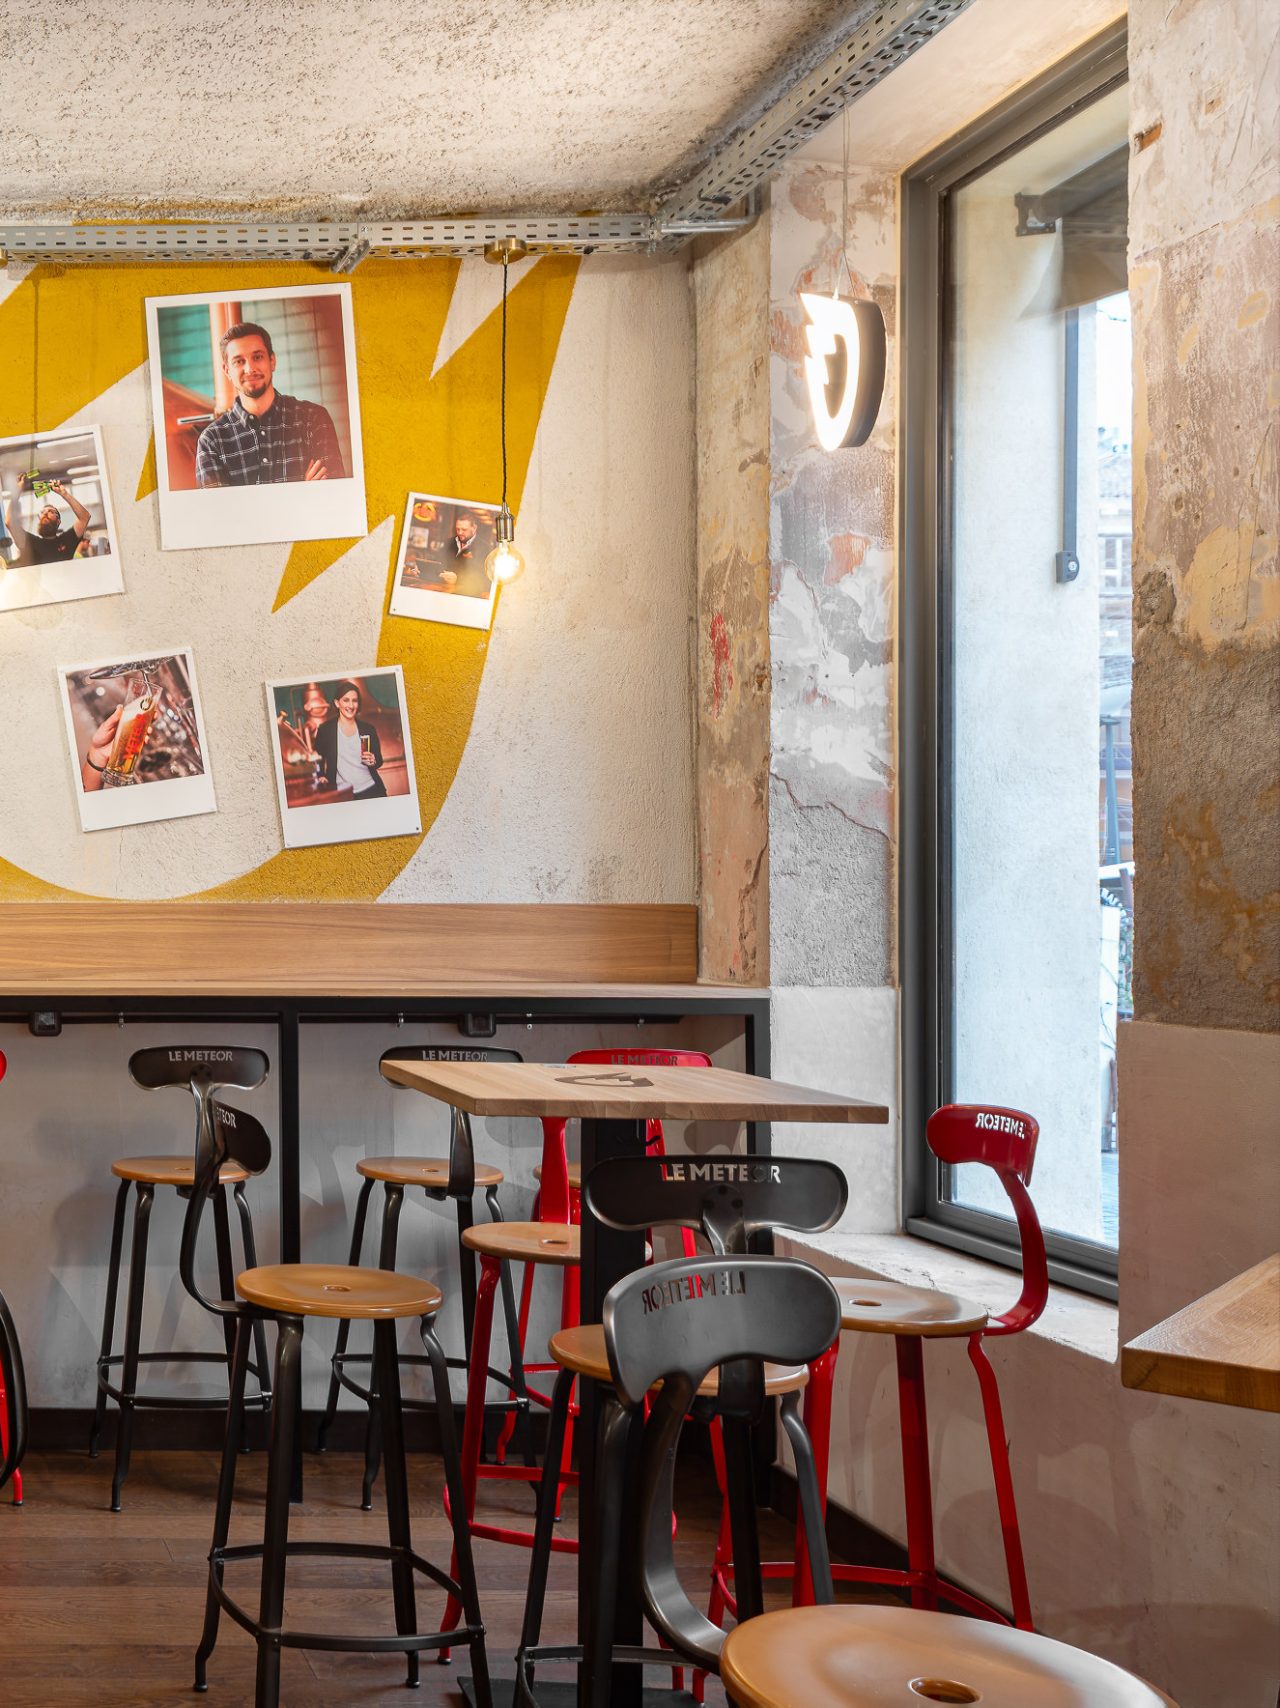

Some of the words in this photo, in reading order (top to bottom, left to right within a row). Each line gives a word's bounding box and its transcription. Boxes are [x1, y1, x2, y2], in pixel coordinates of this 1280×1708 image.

[168, 1051, 182, 1062] LE
[183, 1050, 233, 1062] METEOR
[422, 1050, 436, 1061] LE
[438, 1050, 488, 1062] METEOR
[660, 1163, 686, 1181] LE
[689, 1163, 781, 1184] METEOR
